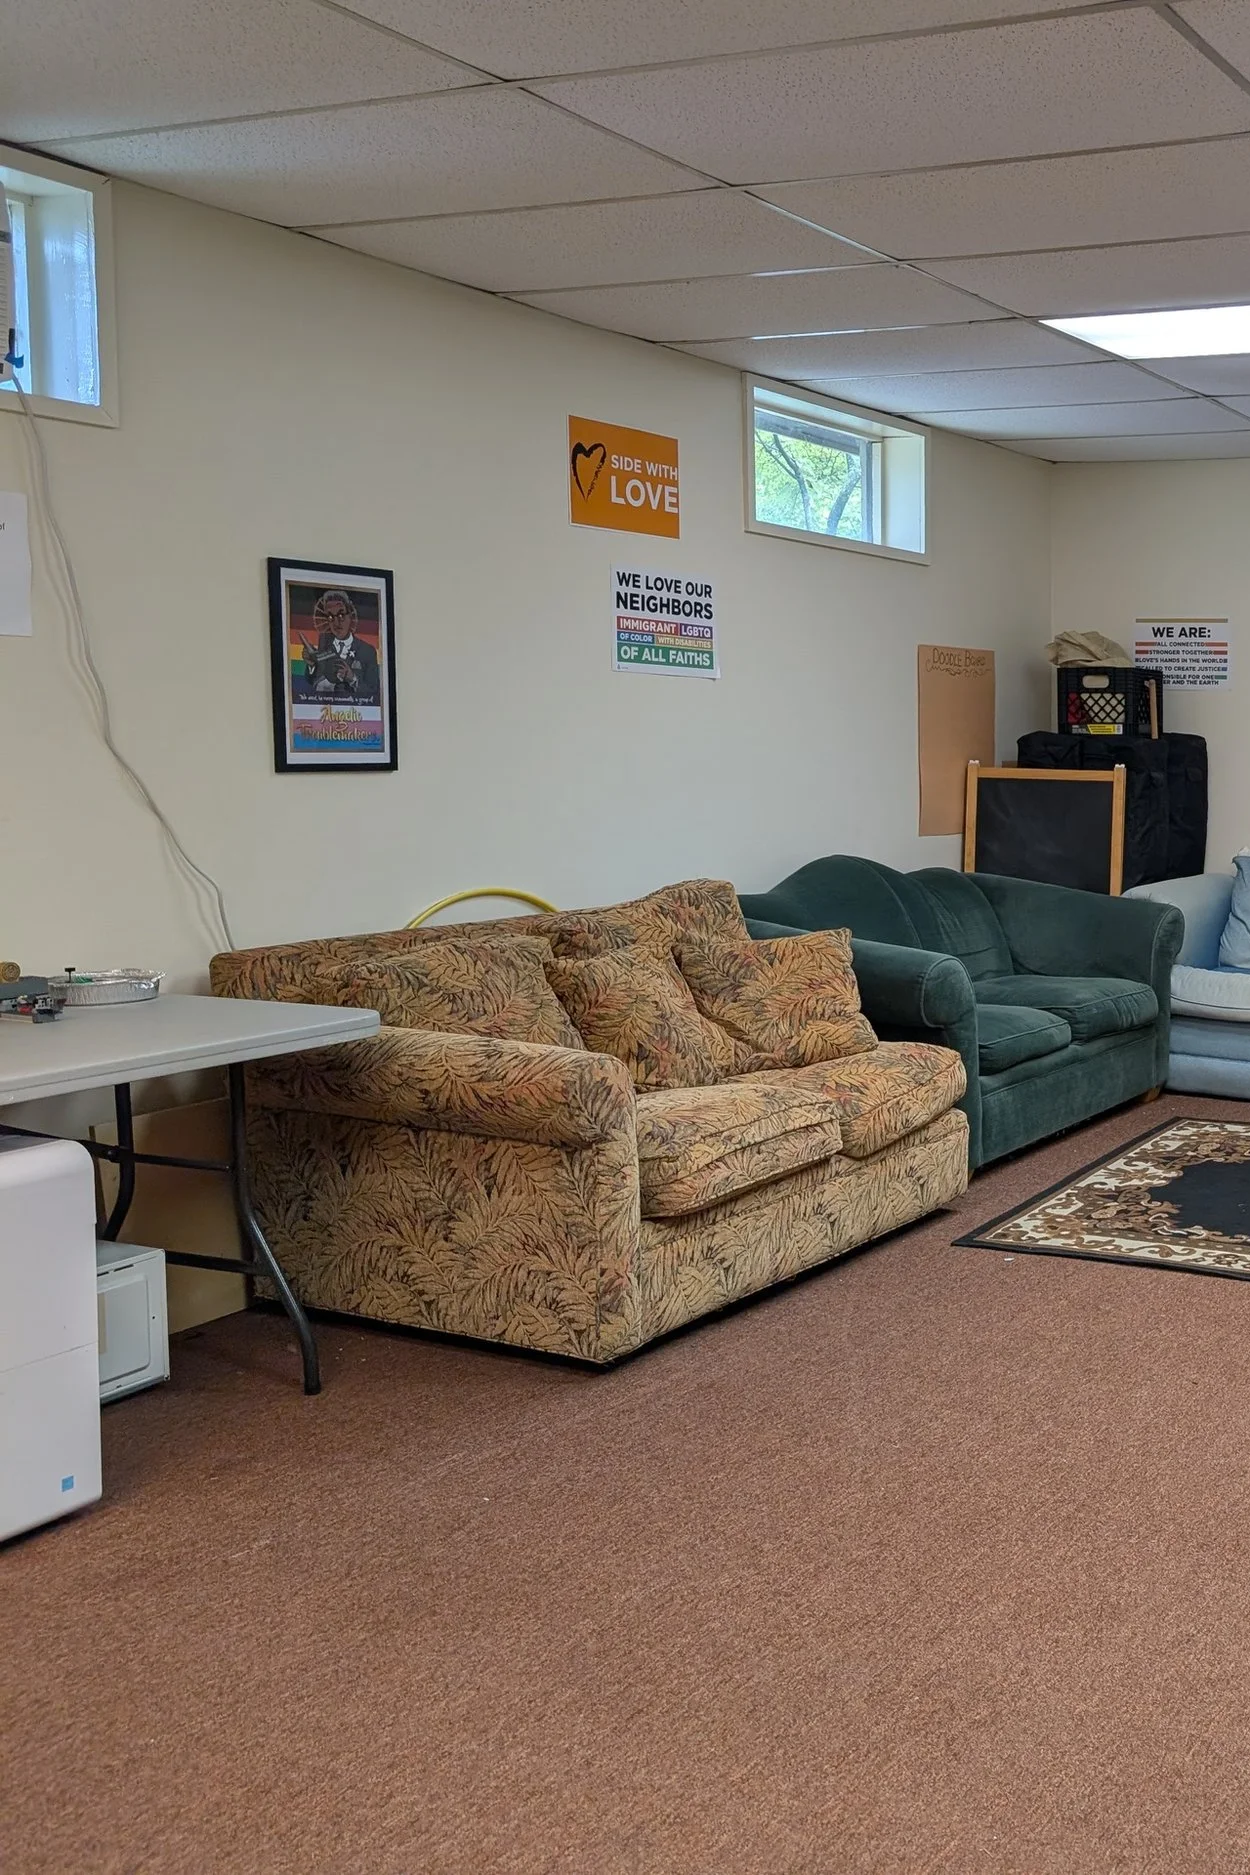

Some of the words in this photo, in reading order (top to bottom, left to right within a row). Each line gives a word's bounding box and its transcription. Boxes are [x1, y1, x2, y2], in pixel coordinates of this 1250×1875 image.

[611, 454, 642, 474] SIDE
[646, 461, 678, 480] WITH
[611, 476, 678, 513] LOVE
[616, 572, 640, 588] WE
[646, 576, 682, 594] LOVE
[686, 582, 712, 598] OUR
[616, 591, 714, 620] NEIGHBORS
[620, 618, 676, 634] IMMIGRANT
[682, 625, 711, 638] LGBTQ
[1152, 627, 1174, 638] WE
[1178, 627, 1211, 638] ARE:
[630, 634, 653, 643] COLOR
[658, 636, 674, 645] WITH
[676, 638, 712, 649] DISABILITIES
[620, 646, 638, 660] OF
[642, 648, 666, 662] ALL
[670, 650, 710, 666] FAITHS
[320, 704, 362, 731] Angelic
